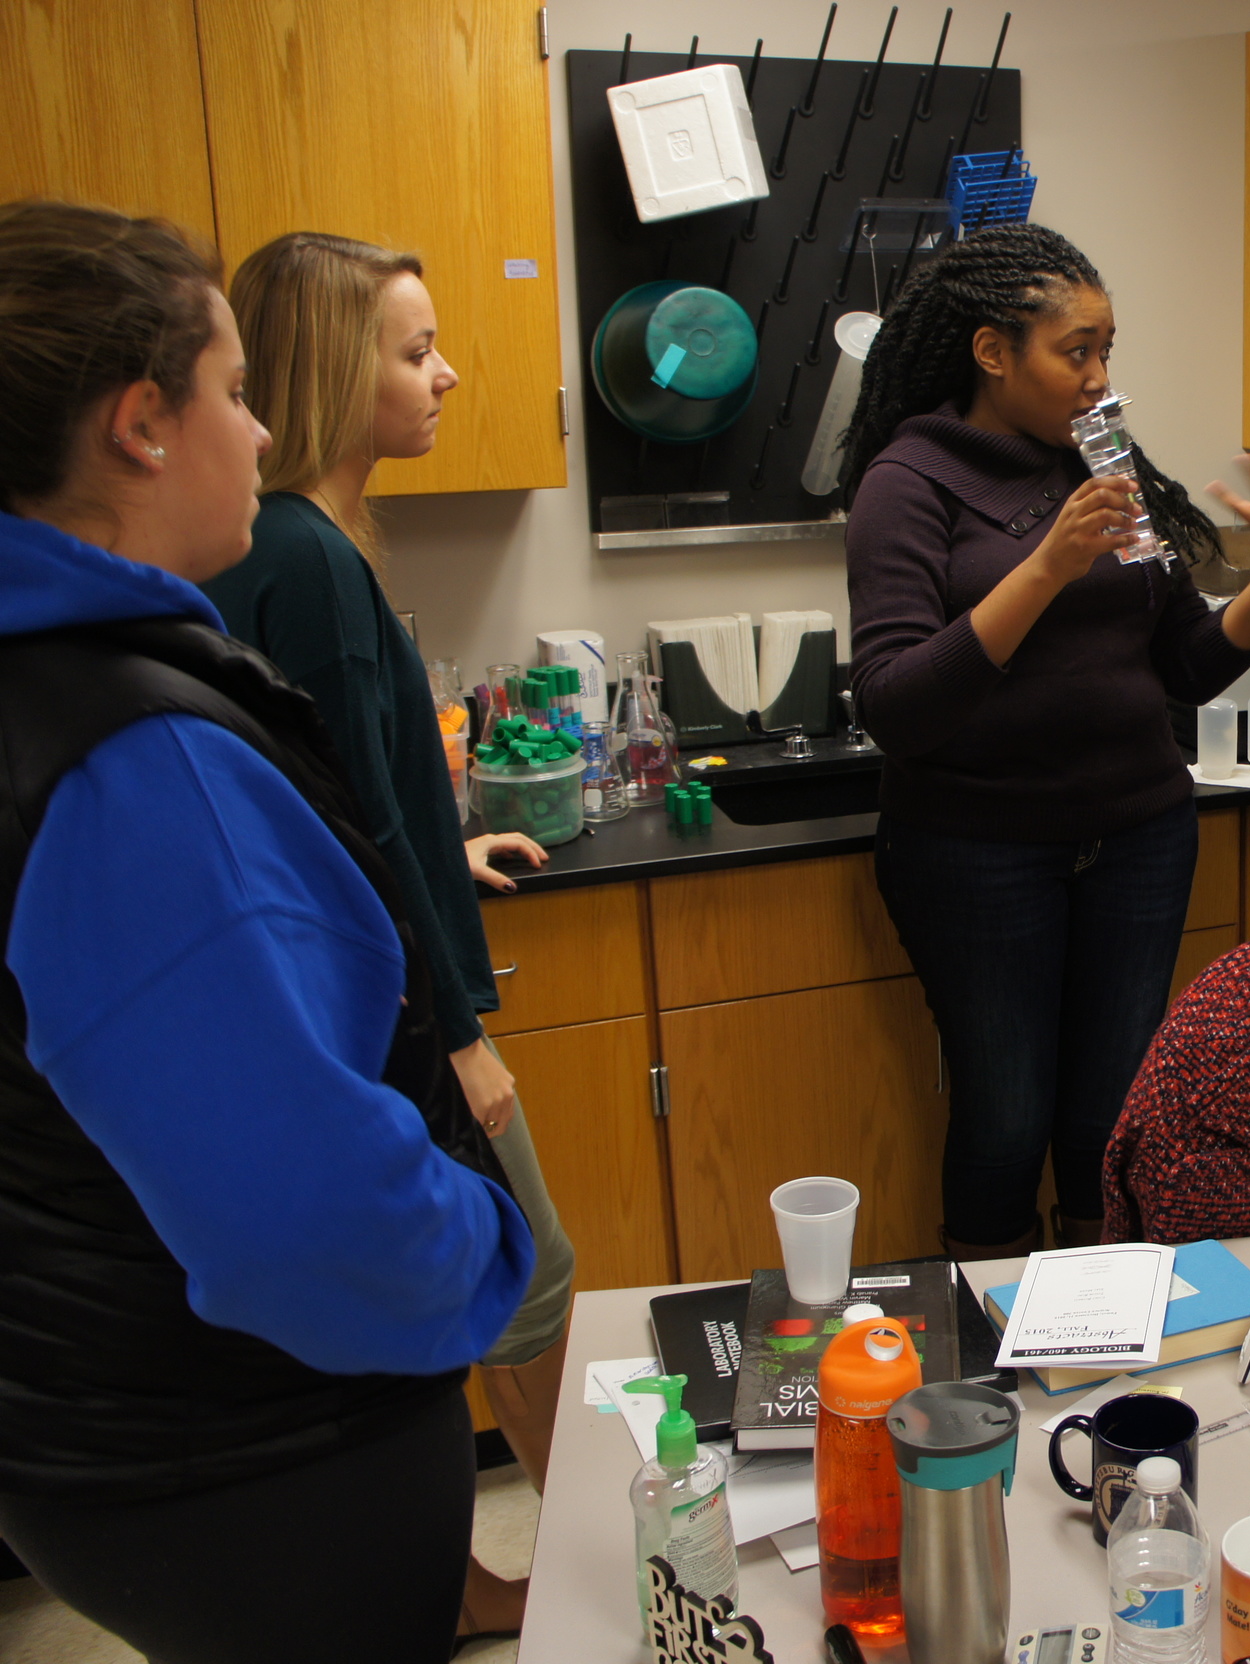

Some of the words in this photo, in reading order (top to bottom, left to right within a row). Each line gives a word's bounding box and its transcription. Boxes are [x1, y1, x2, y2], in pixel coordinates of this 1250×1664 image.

[703, 1320, 732, 1377] LABORATORY
[1070, 1345, 1132, 1354] BIOLOGY
[849, 1398, 893, 1411] nalgene
